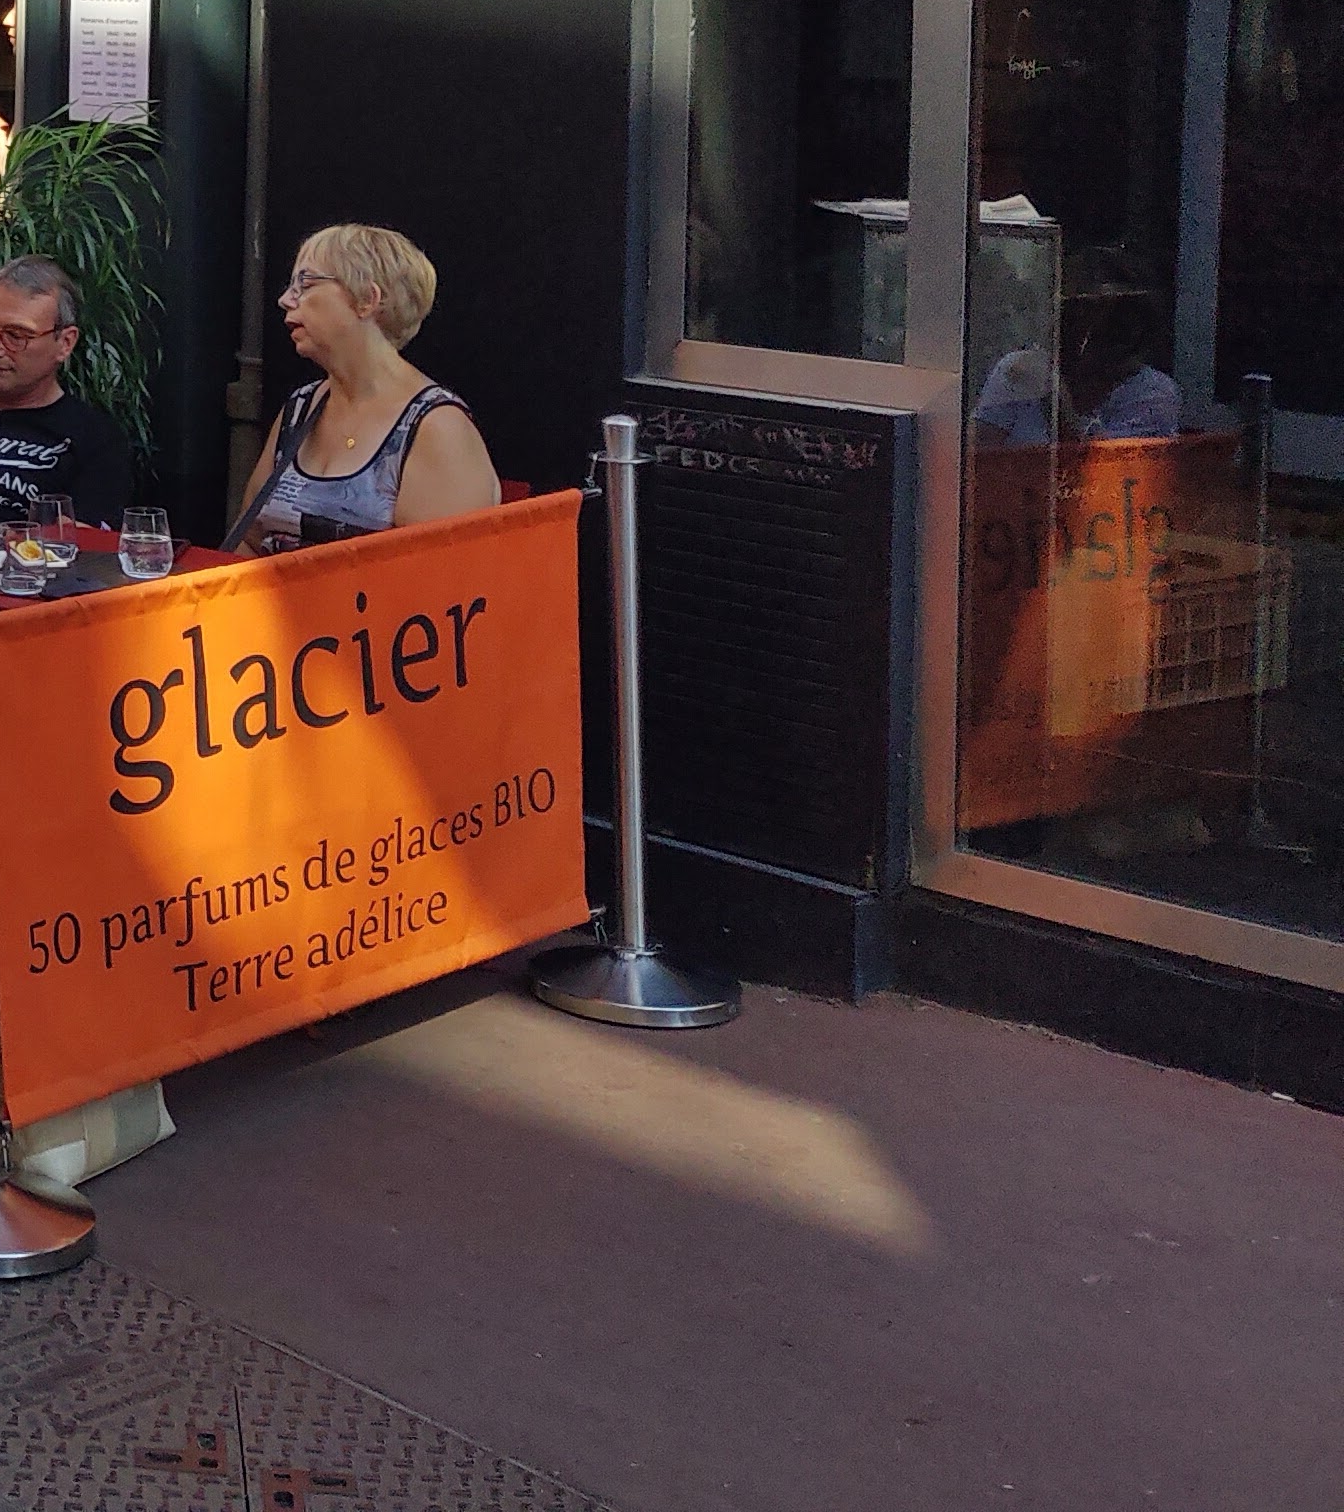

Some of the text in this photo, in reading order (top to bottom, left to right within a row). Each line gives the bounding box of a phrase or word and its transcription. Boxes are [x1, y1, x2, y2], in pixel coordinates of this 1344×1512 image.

[109, 591, 487, 815] glacier
[29, 767, 557, 975] 50 parfums de glaces BIO
[173, 889, 448, 1012] Terre adélice
